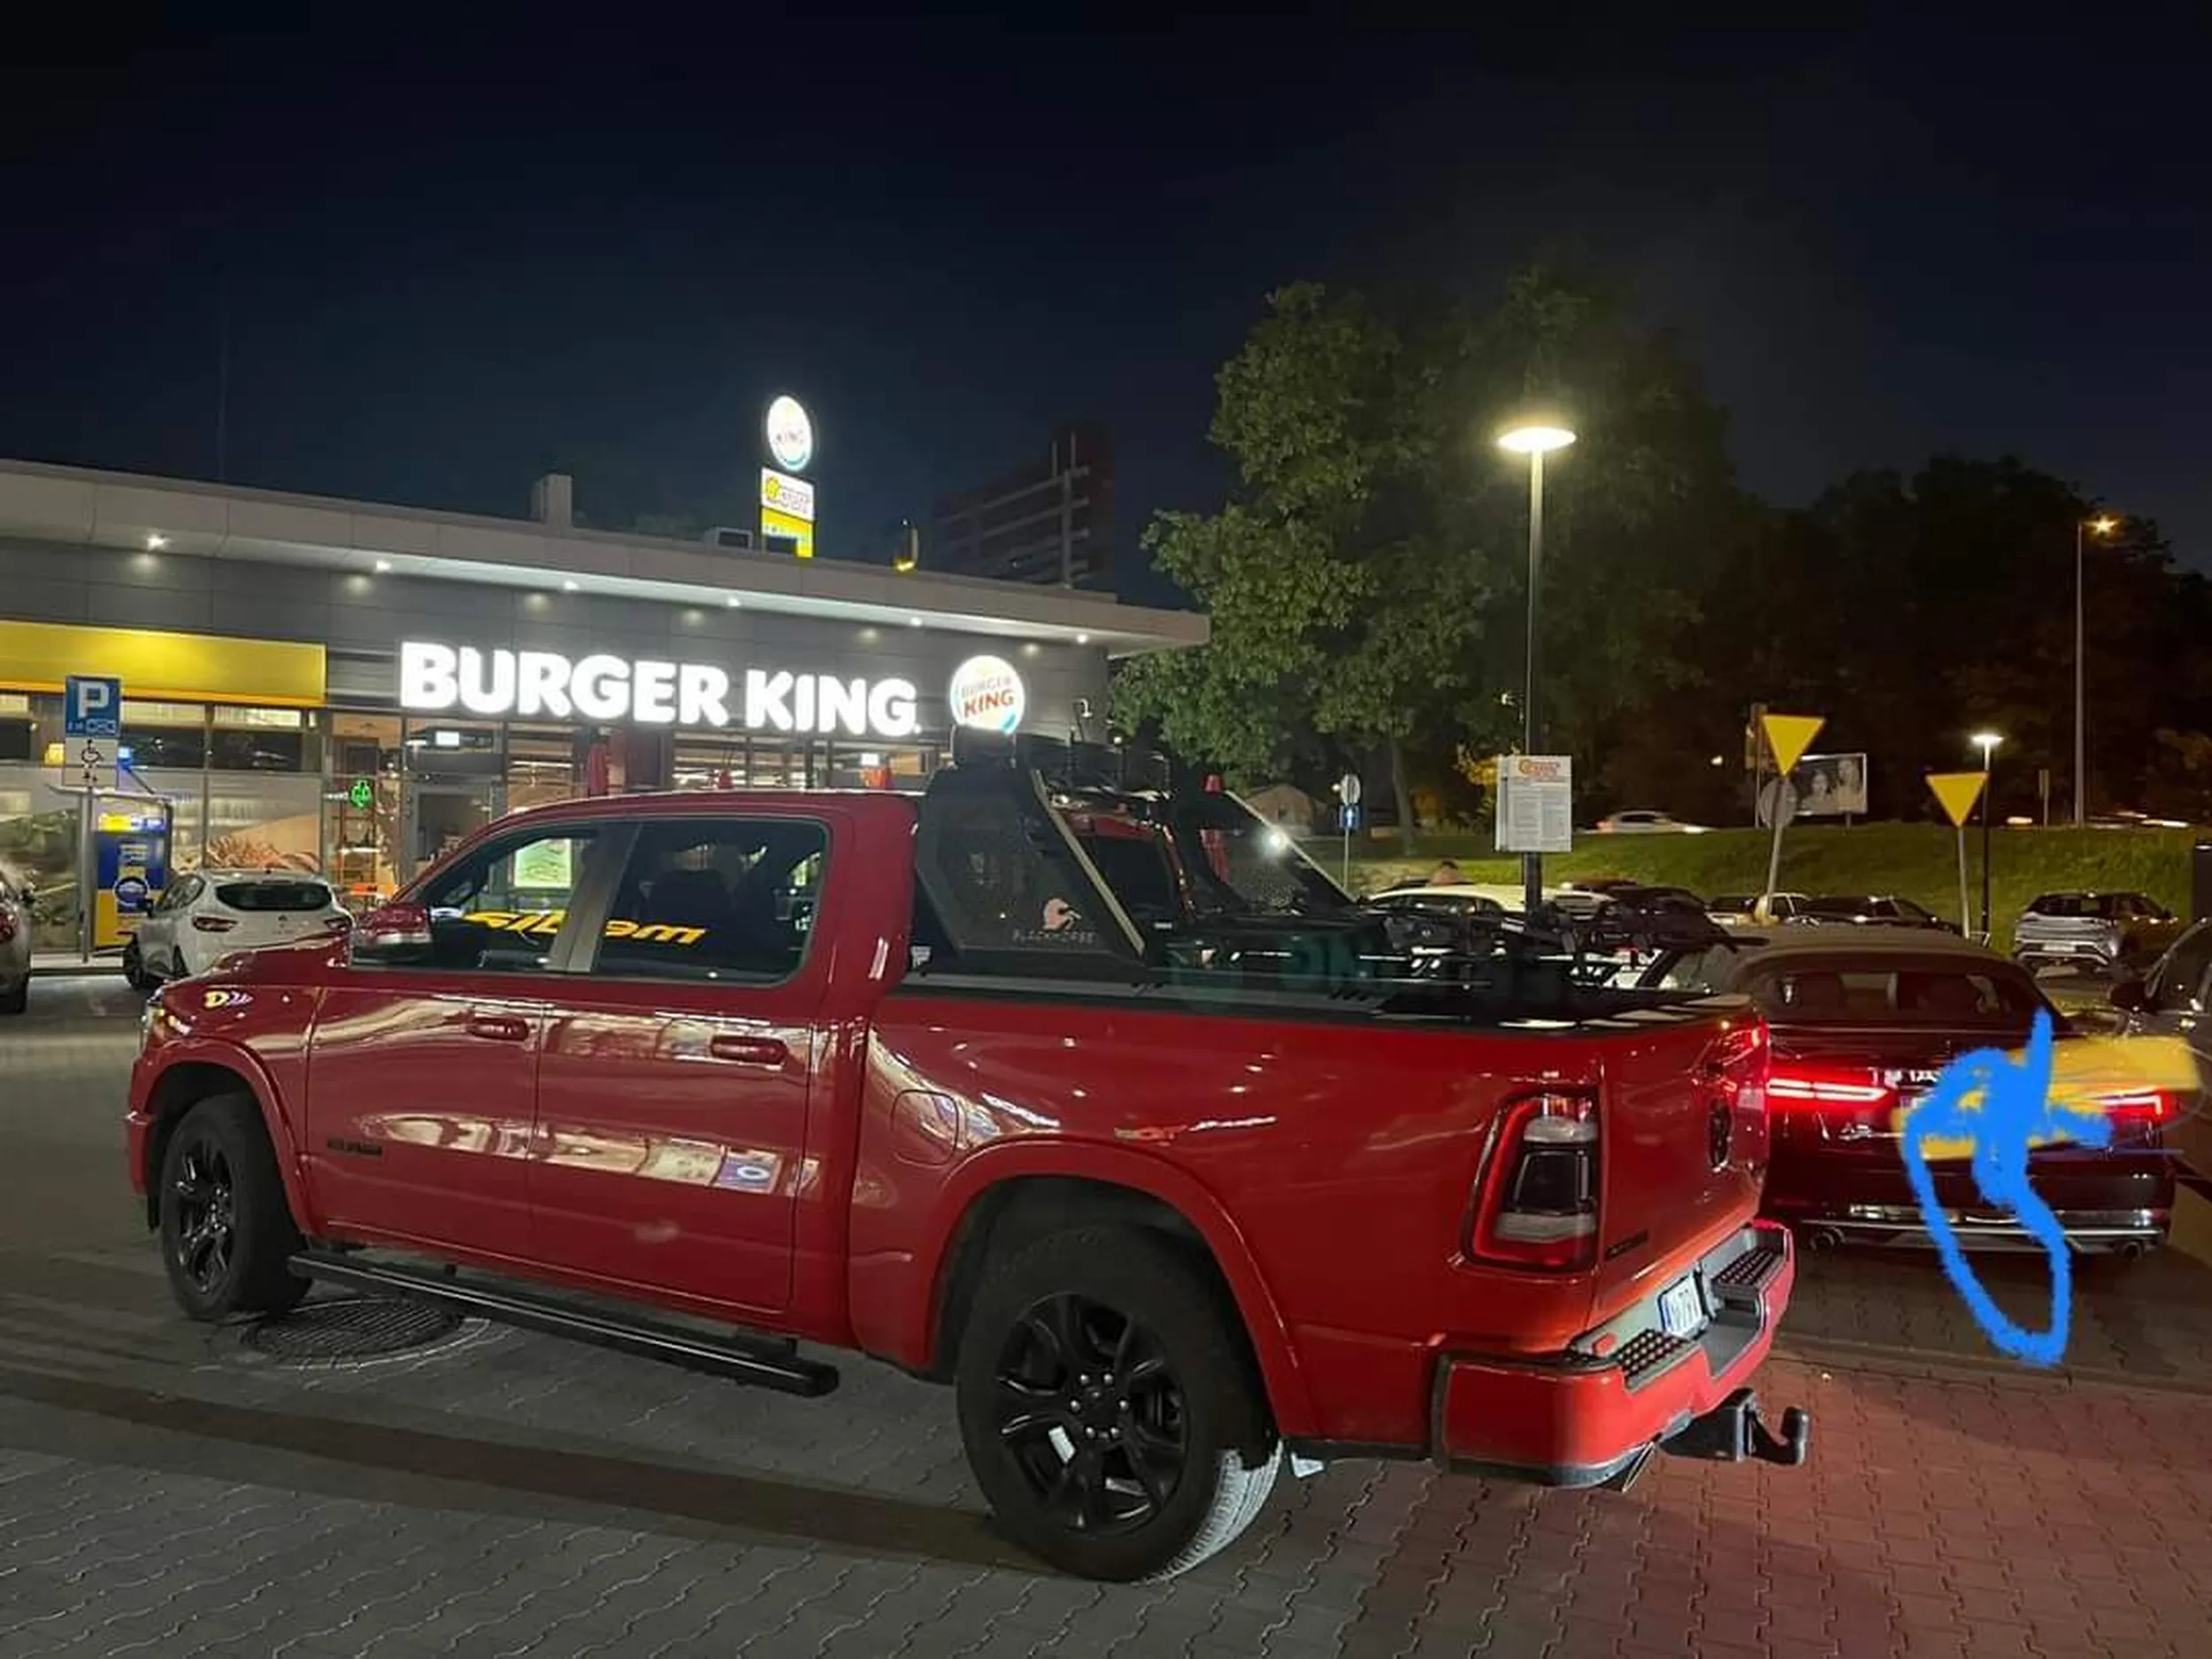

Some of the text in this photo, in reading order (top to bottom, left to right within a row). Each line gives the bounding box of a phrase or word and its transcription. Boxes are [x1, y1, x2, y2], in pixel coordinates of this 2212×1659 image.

[78, 681, 109, 718] P
[400, 641, 730, 727] BURGER
[964, 689, 1015, 718] KING
